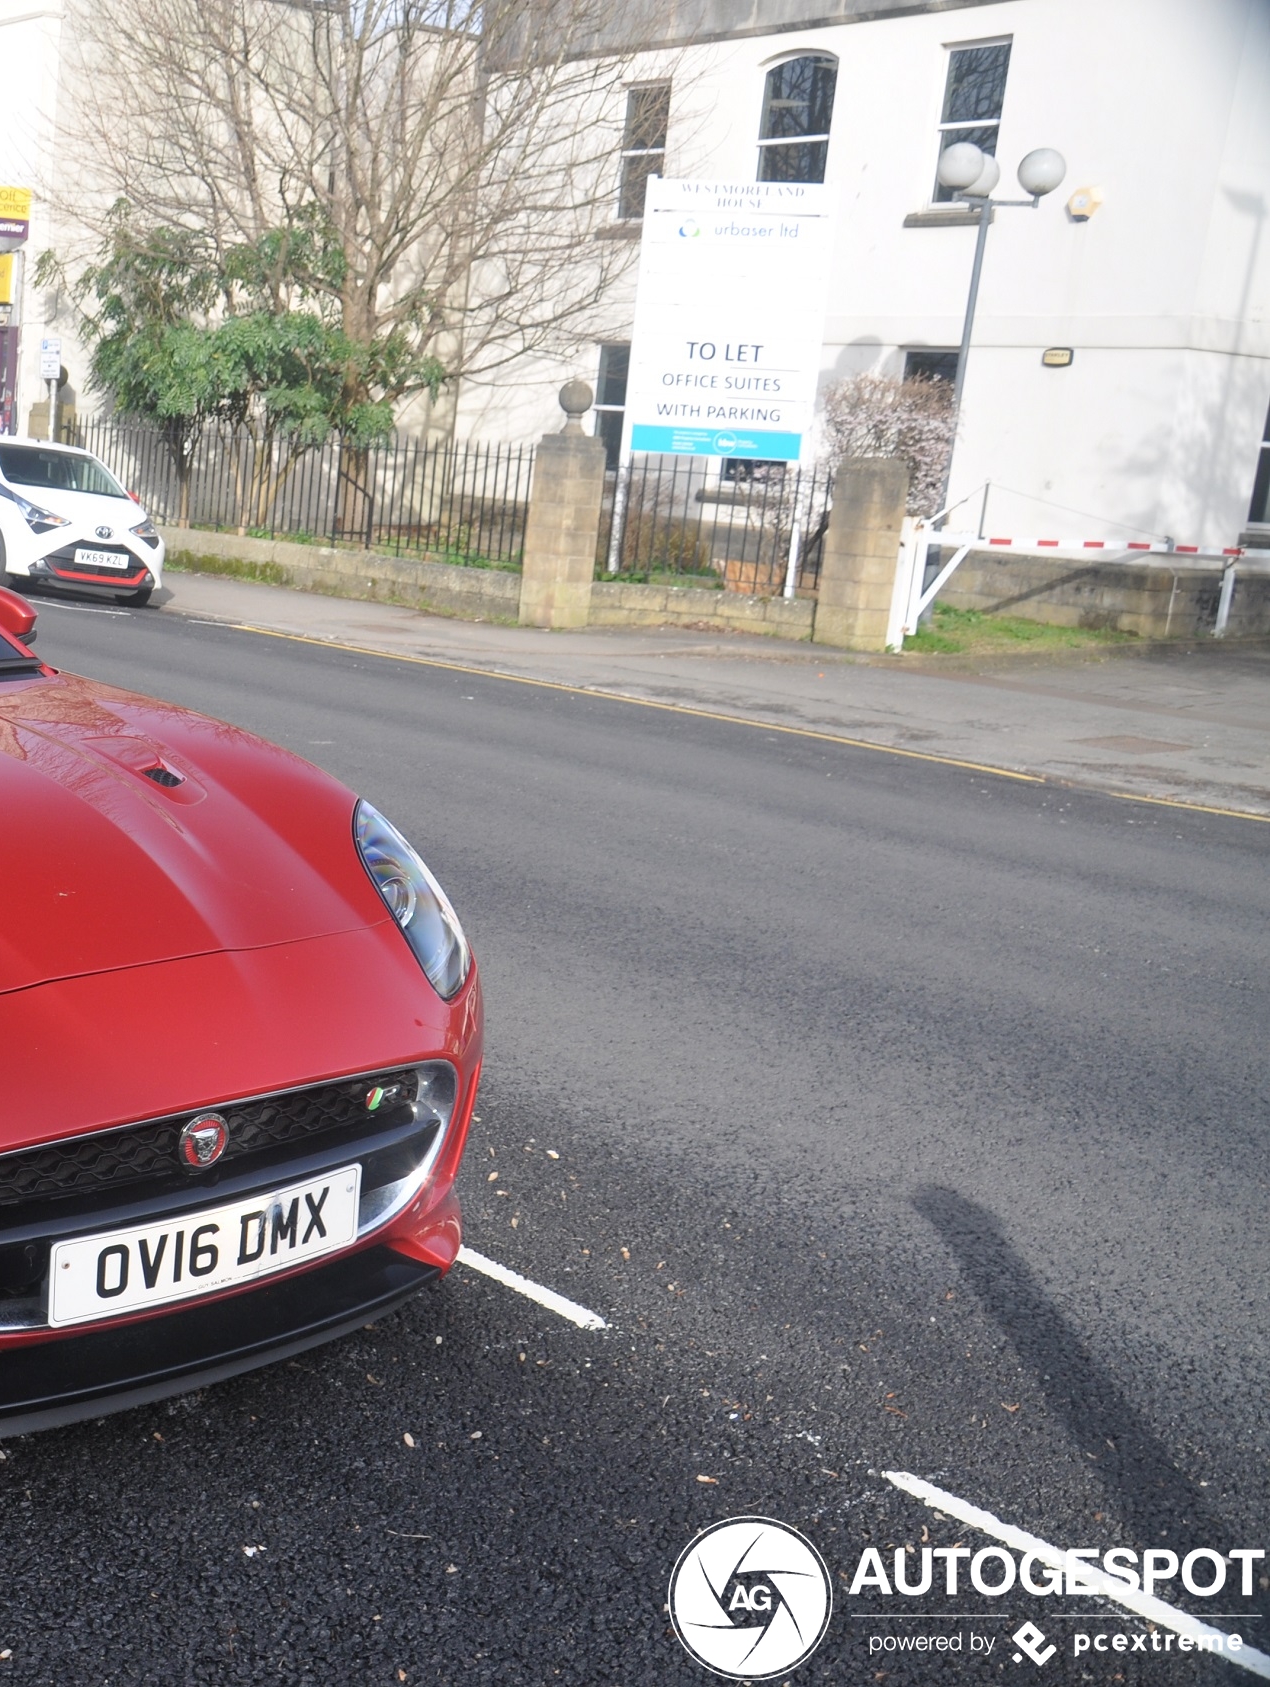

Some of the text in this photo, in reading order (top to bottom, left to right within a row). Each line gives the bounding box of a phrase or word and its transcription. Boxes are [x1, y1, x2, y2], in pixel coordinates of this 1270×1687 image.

[0, 189, 17, 202] Off
[682, 183, 805, 197] WESTMORELAND
[716, 198, 763, 209] HOUSE
[714, 221, 799, 238] urbaser ltd
[686, 341, 764, 362] TO LET
[662, 373, 781, 392] OFFICE SUITES
[657, 403, 782, 422] WITH PARKING
[81, 551, 123, 566] VK69 KZL
[95, 1186, 330, 1299] OV16 DMX
